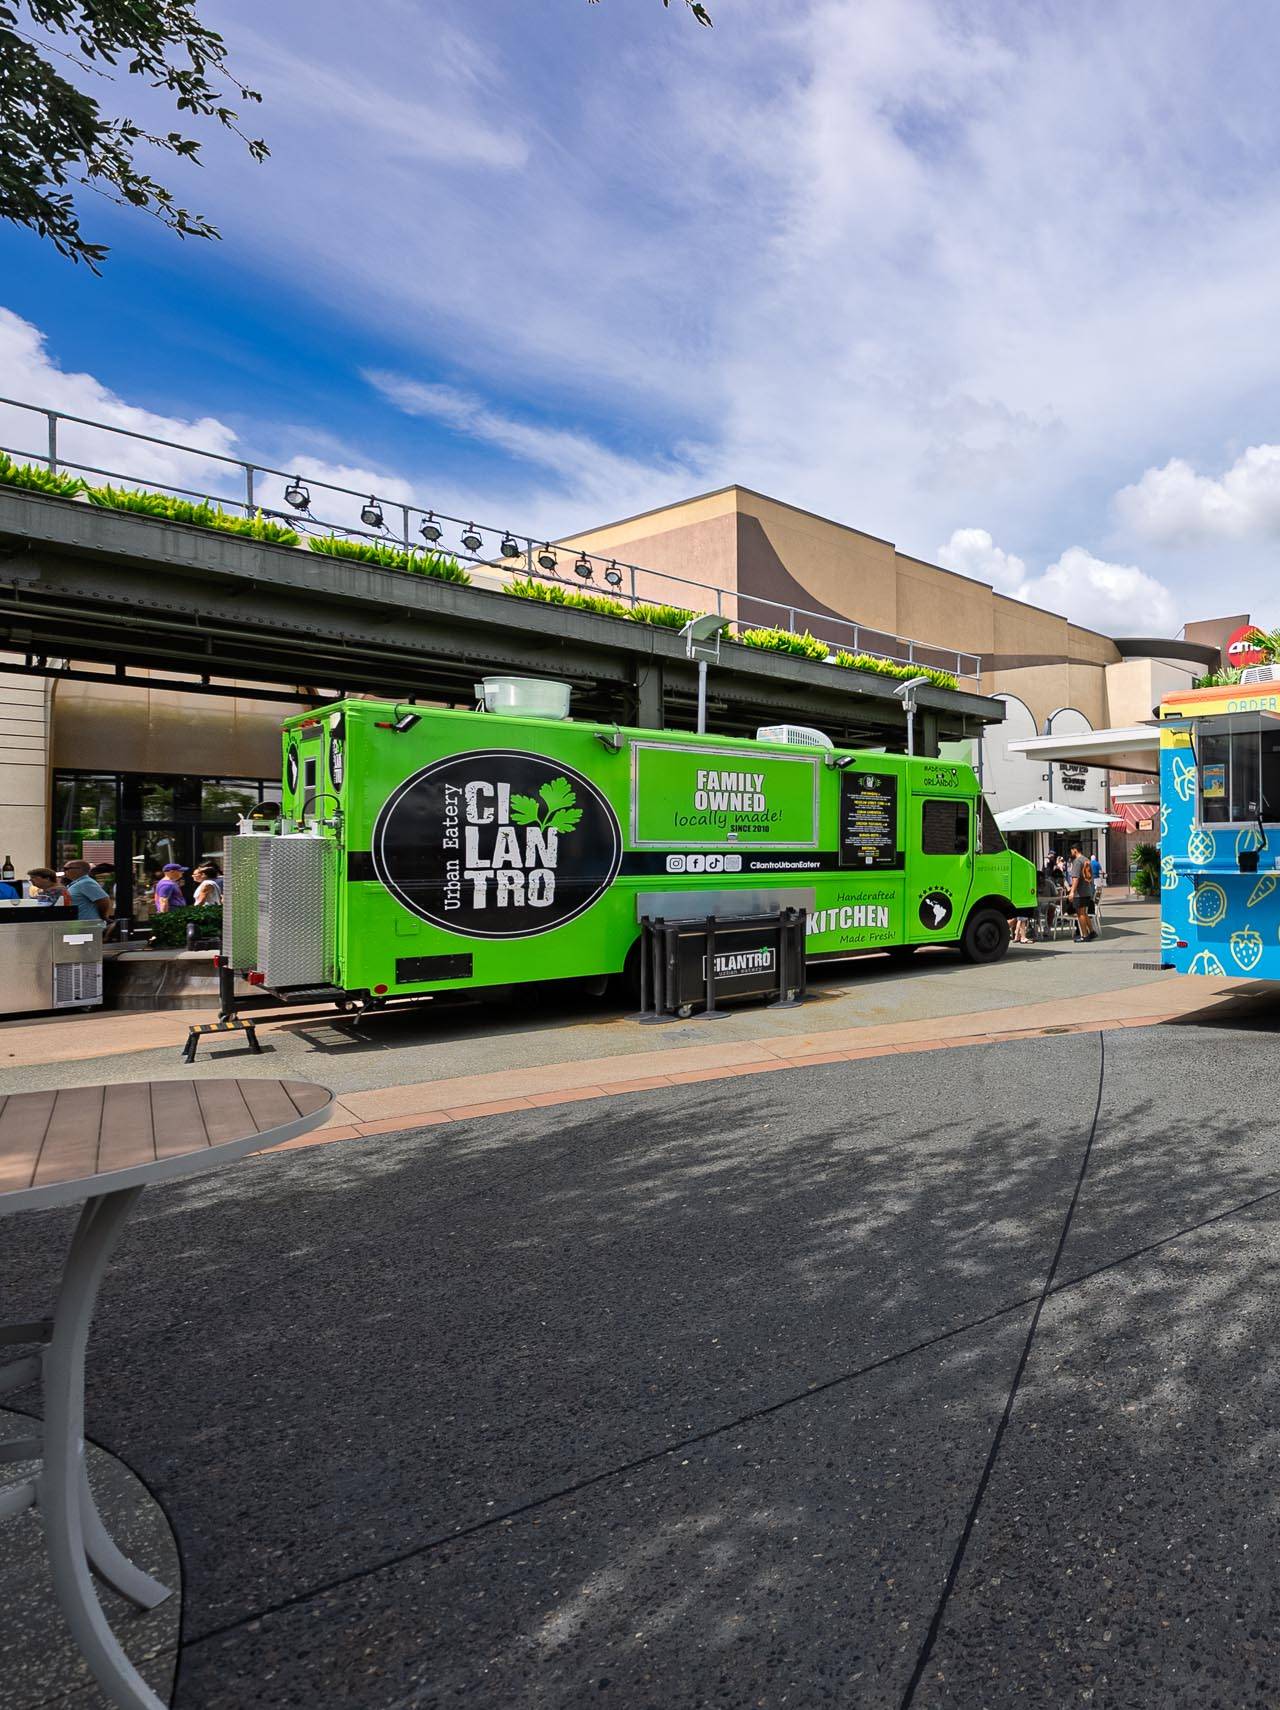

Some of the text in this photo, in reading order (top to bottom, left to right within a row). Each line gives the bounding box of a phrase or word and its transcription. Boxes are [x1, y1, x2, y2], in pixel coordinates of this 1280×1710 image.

[1228, 697, 1277, 712] ORDER
[697, 769, 765, 792] FAMILY
[694, 790, 766, 812] OWNED
[674, 809, 784, 829] locally made!
[730, 825, 751, 833] SINCE
[443, 783, 463, 911] Urban Eatery
[465, 826, 558, 868] LAN
[464, 868, 556, 909] TRO
[837, 890, 896, 902] Handcrafted
[806, 904, 889, 935] KITCHEN
[839, 930, 896, 944] Made Fresh!
[714, 952, 771, 972] ILANTRO
